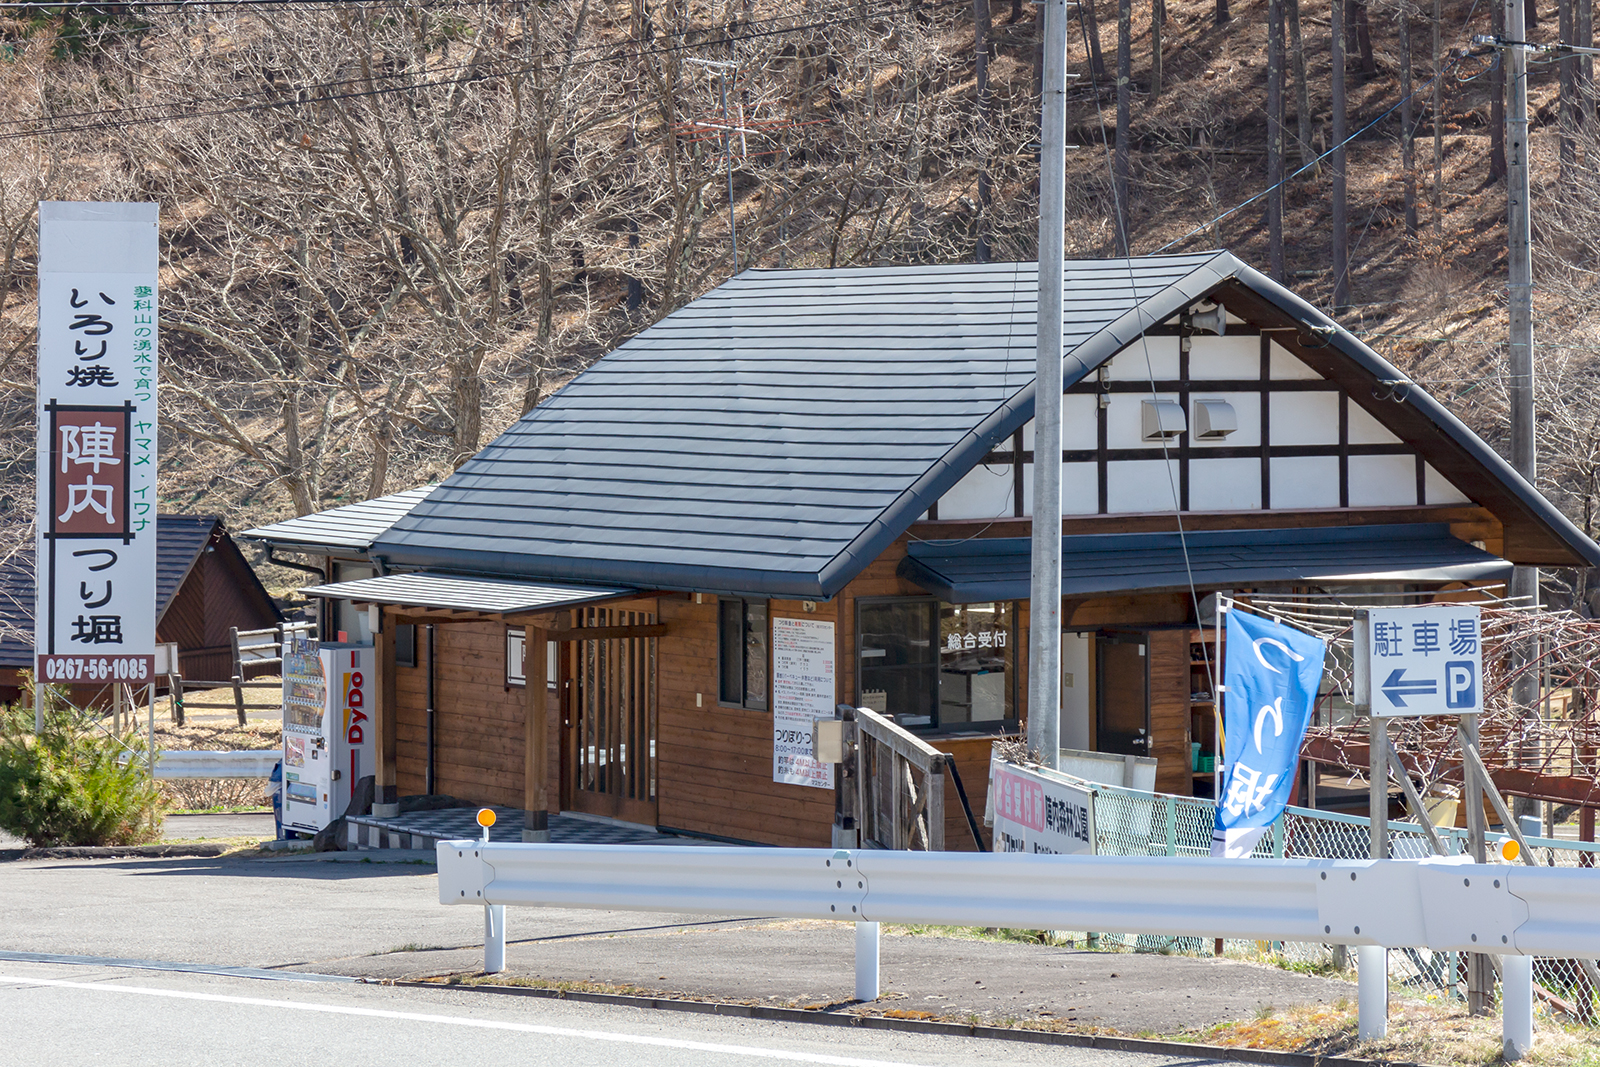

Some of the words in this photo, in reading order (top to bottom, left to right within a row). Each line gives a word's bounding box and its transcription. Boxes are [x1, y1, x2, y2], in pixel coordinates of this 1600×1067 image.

[65, 288, 119, 387] いろり焼
[133, 285, 153, 402] 蓼科山の湧水で育つ
[58, 421, 121, 524] 陣内
[133, 420, 152, 531] ヤマメ・イワナ
[70, 549, 123, 644] つり堀
[947, 630, 1008, 650] 総合受付
[1374, 618, 1477, 657] 駐車場
[46, 658, 148, 680] 0267-56-1085
[1449, 666, 1472, 703] P
[347, 671, 369, 744] DyDo
[775, 729, 813, 744] つりぼり・つ
[1044, 794, 1090, 844] 陣内森林公園
